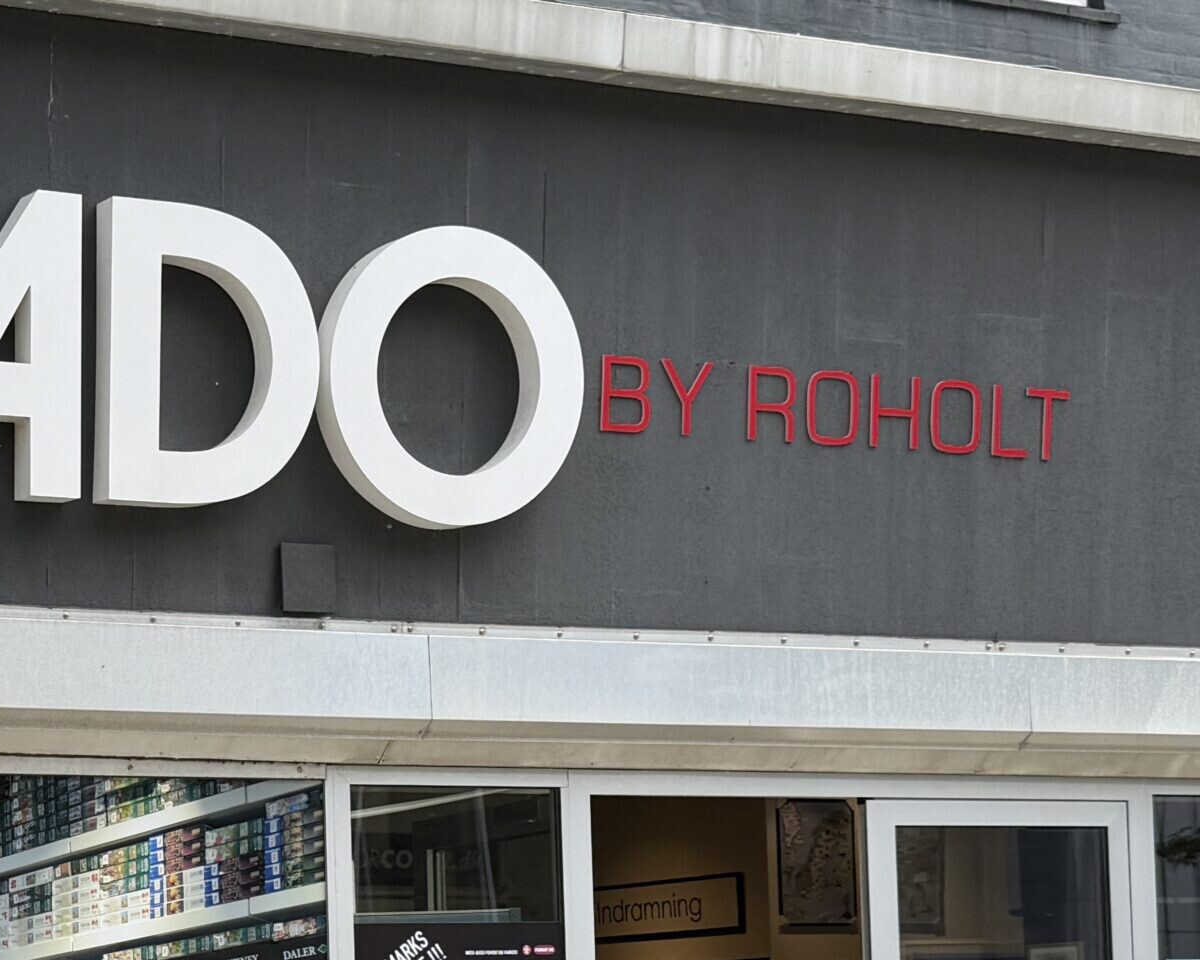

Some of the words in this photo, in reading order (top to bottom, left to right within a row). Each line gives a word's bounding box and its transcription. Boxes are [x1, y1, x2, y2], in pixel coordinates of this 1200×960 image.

[600, 354, 713, 437] BY
[747, 364, 1071, 461] ROHOLT
[283, 946, 316, 960] DALER
